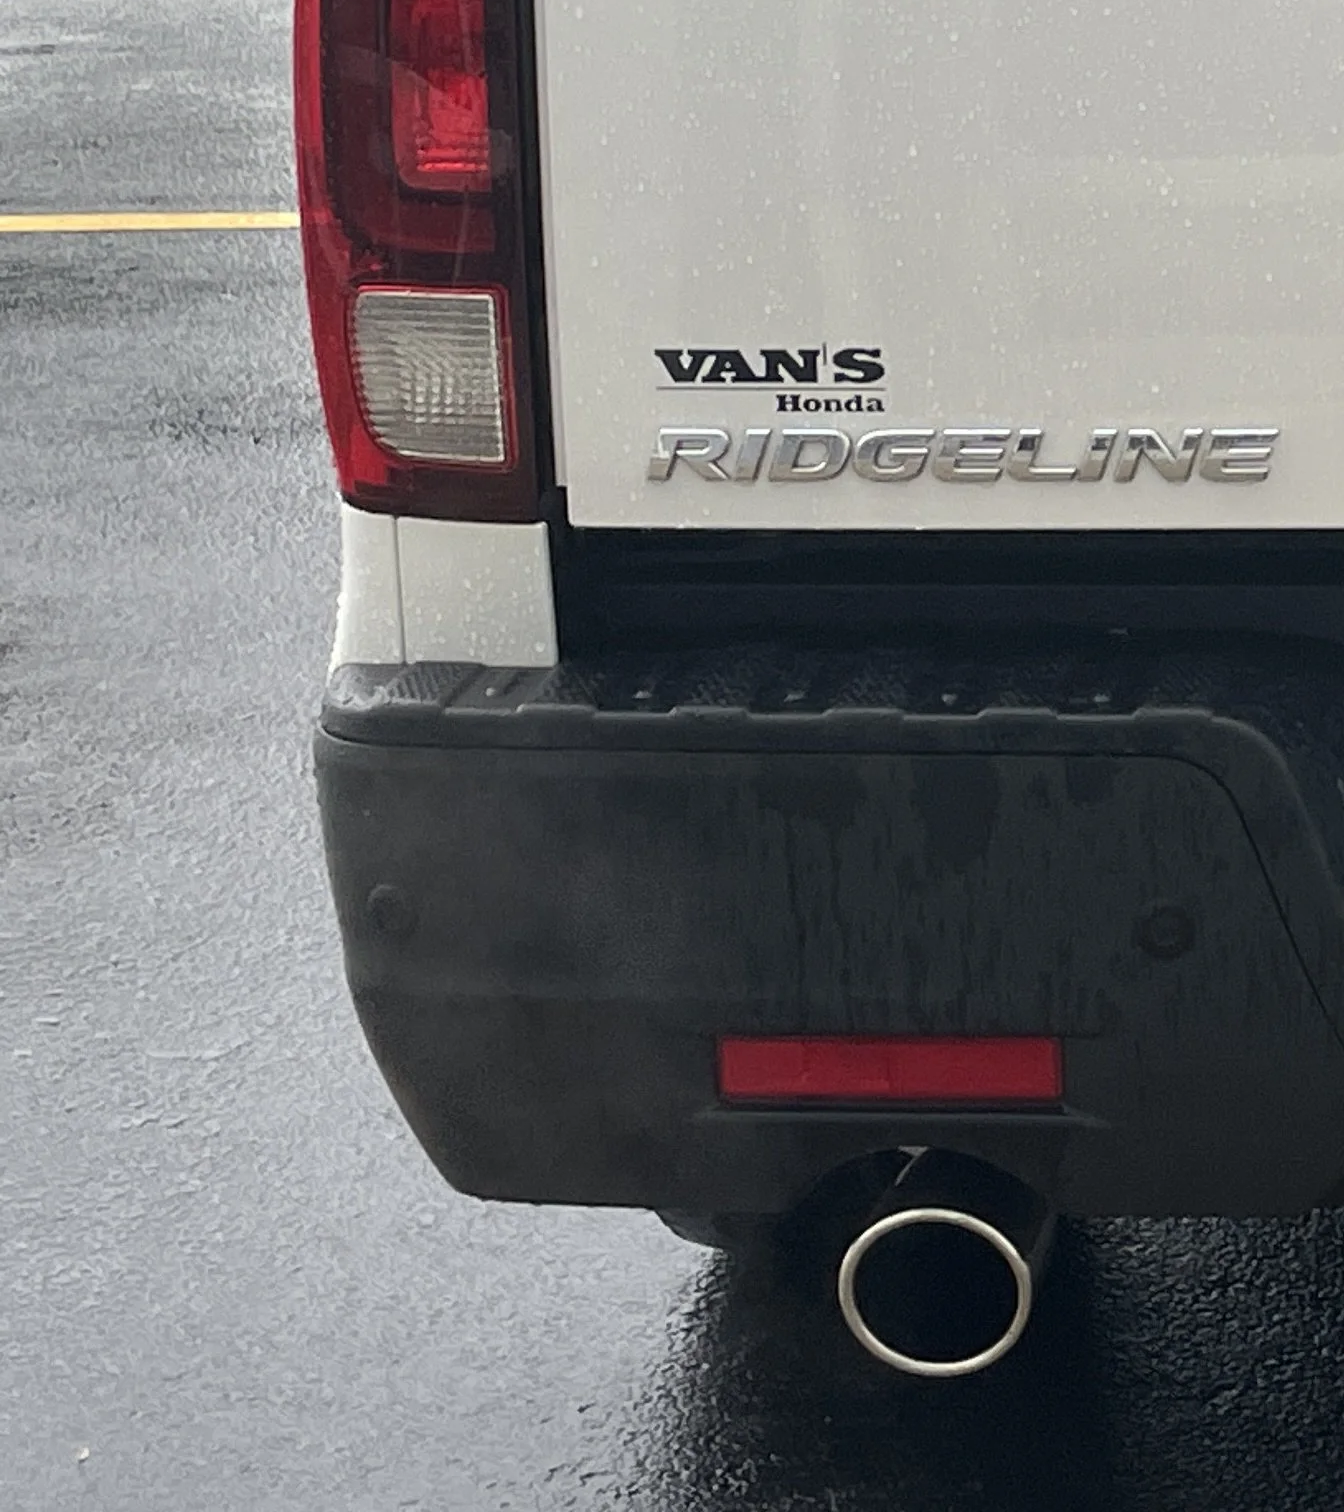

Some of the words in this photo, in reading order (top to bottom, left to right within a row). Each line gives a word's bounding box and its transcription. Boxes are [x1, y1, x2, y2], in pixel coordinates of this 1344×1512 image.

[654, 343, 885, 384] VAN'S
[776, 393, 885, 413] Honda
[647, 426, 1281, 484] RIDGELINE
